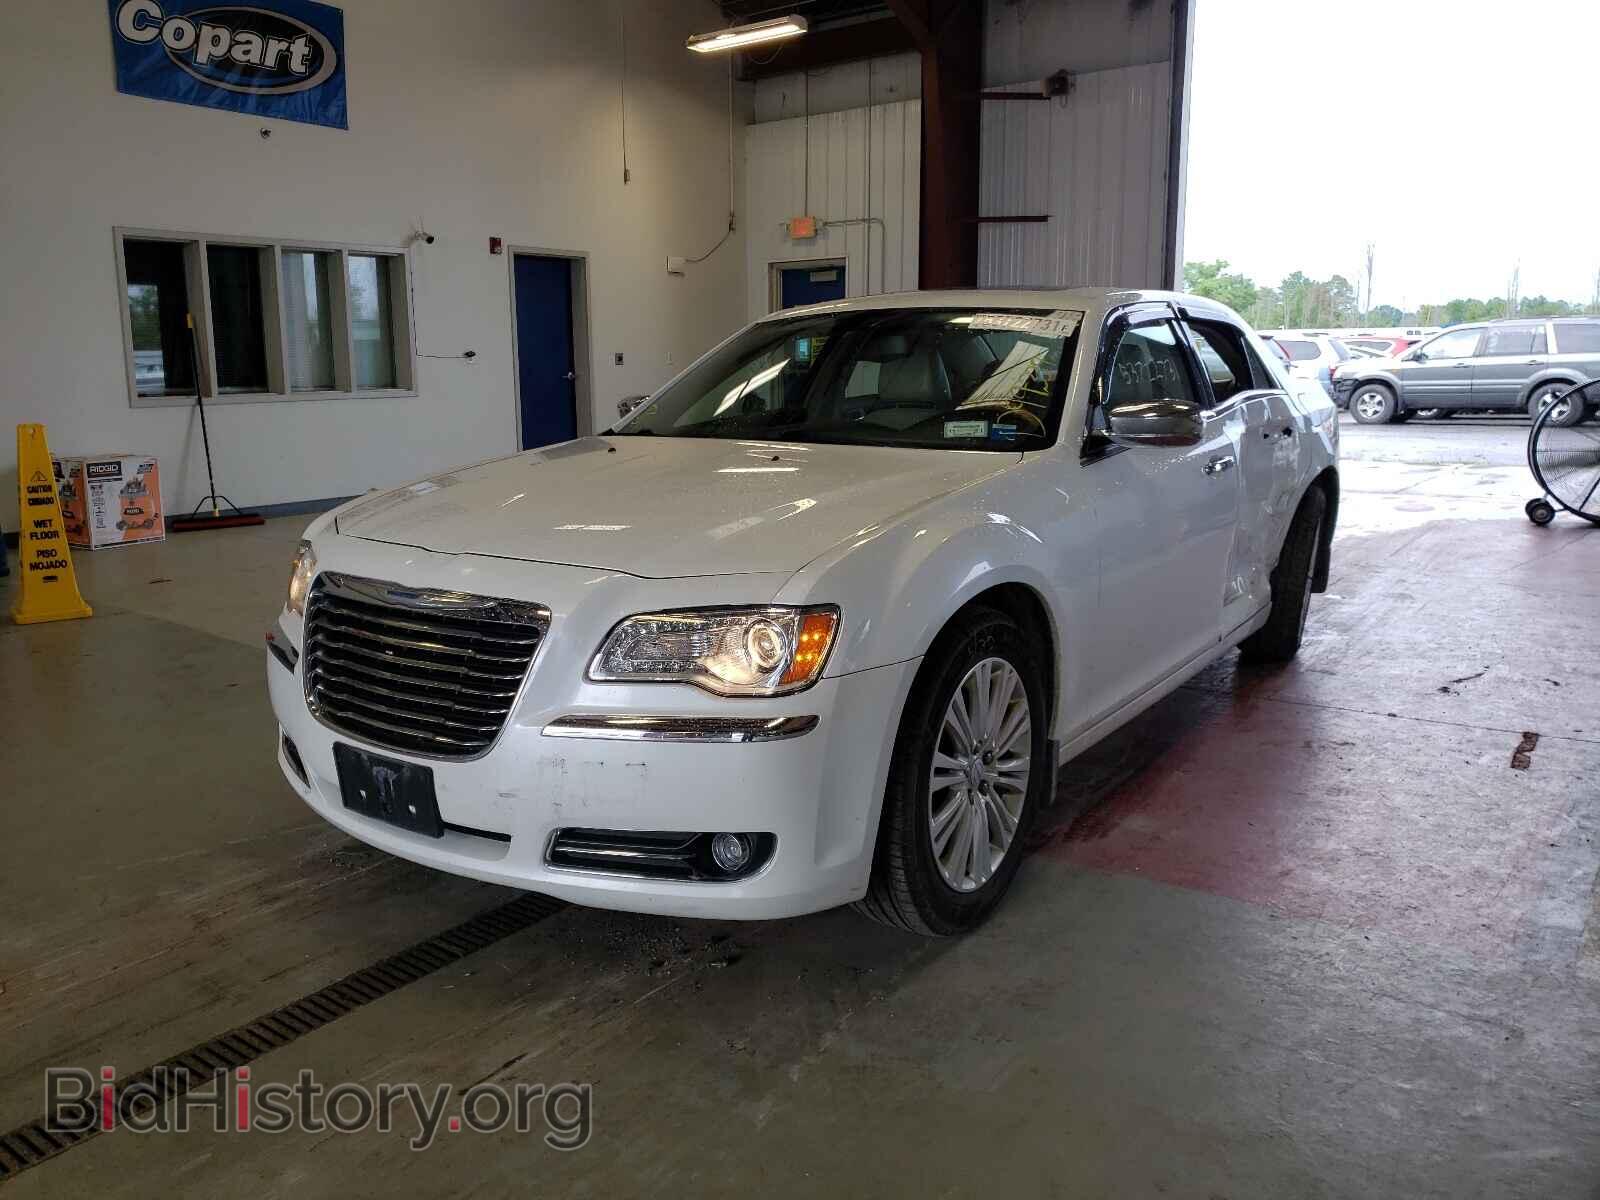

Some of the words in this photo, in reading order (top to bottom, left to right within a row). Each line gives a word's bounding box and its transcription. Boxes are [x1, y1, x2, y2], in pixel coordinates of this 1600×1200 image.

[116, 0, 312, 76] Copart
[89, 464, 119, 474] RIDGID
[33, 519, 53, 528] WET
[30, 530, 60, 540] FLOOR
[36, 549, 57, 558] PISO
[29, 560, 68, 571] MOJADO
